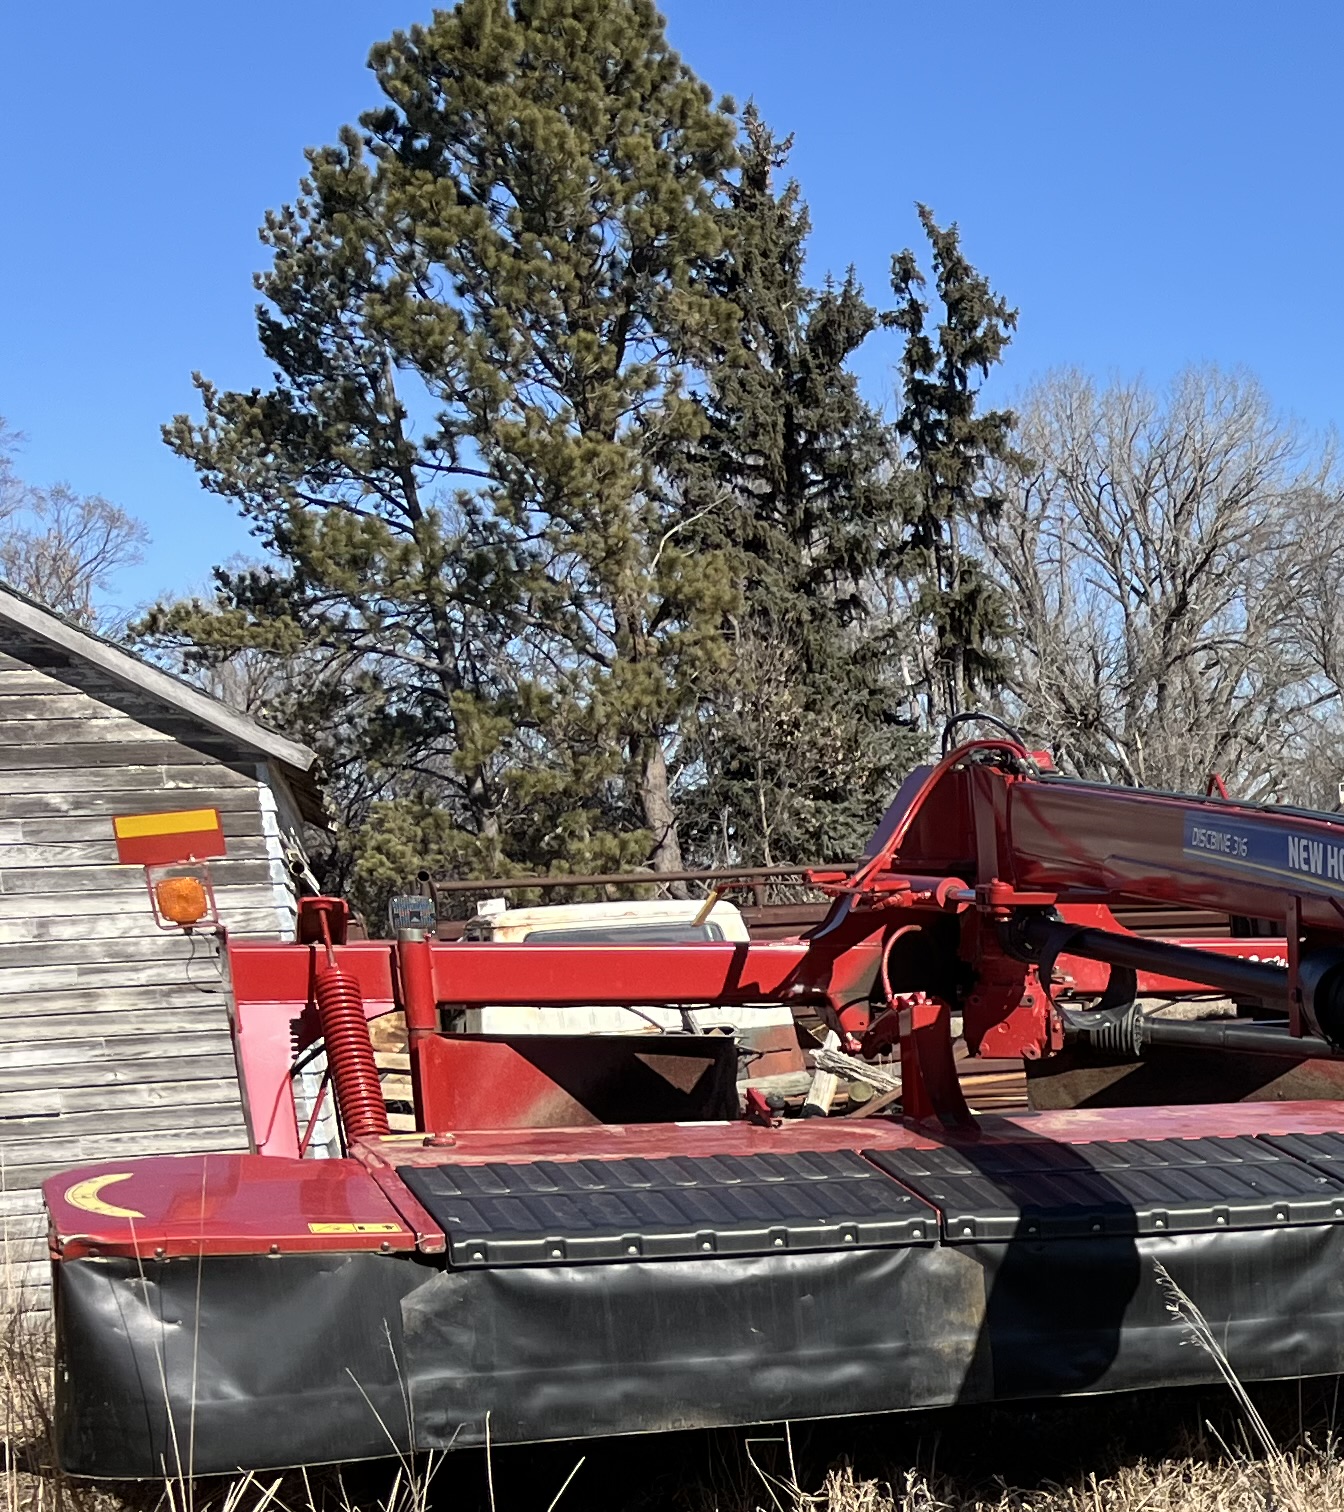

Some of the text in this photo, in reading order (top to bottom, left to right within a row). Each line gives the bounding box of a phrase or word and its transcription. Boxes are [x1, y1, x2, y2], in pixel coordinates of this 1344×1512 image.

[1191, 827, 1248, 857] DISCBINE 316
[1287, 835, 1324, 875] NEW
